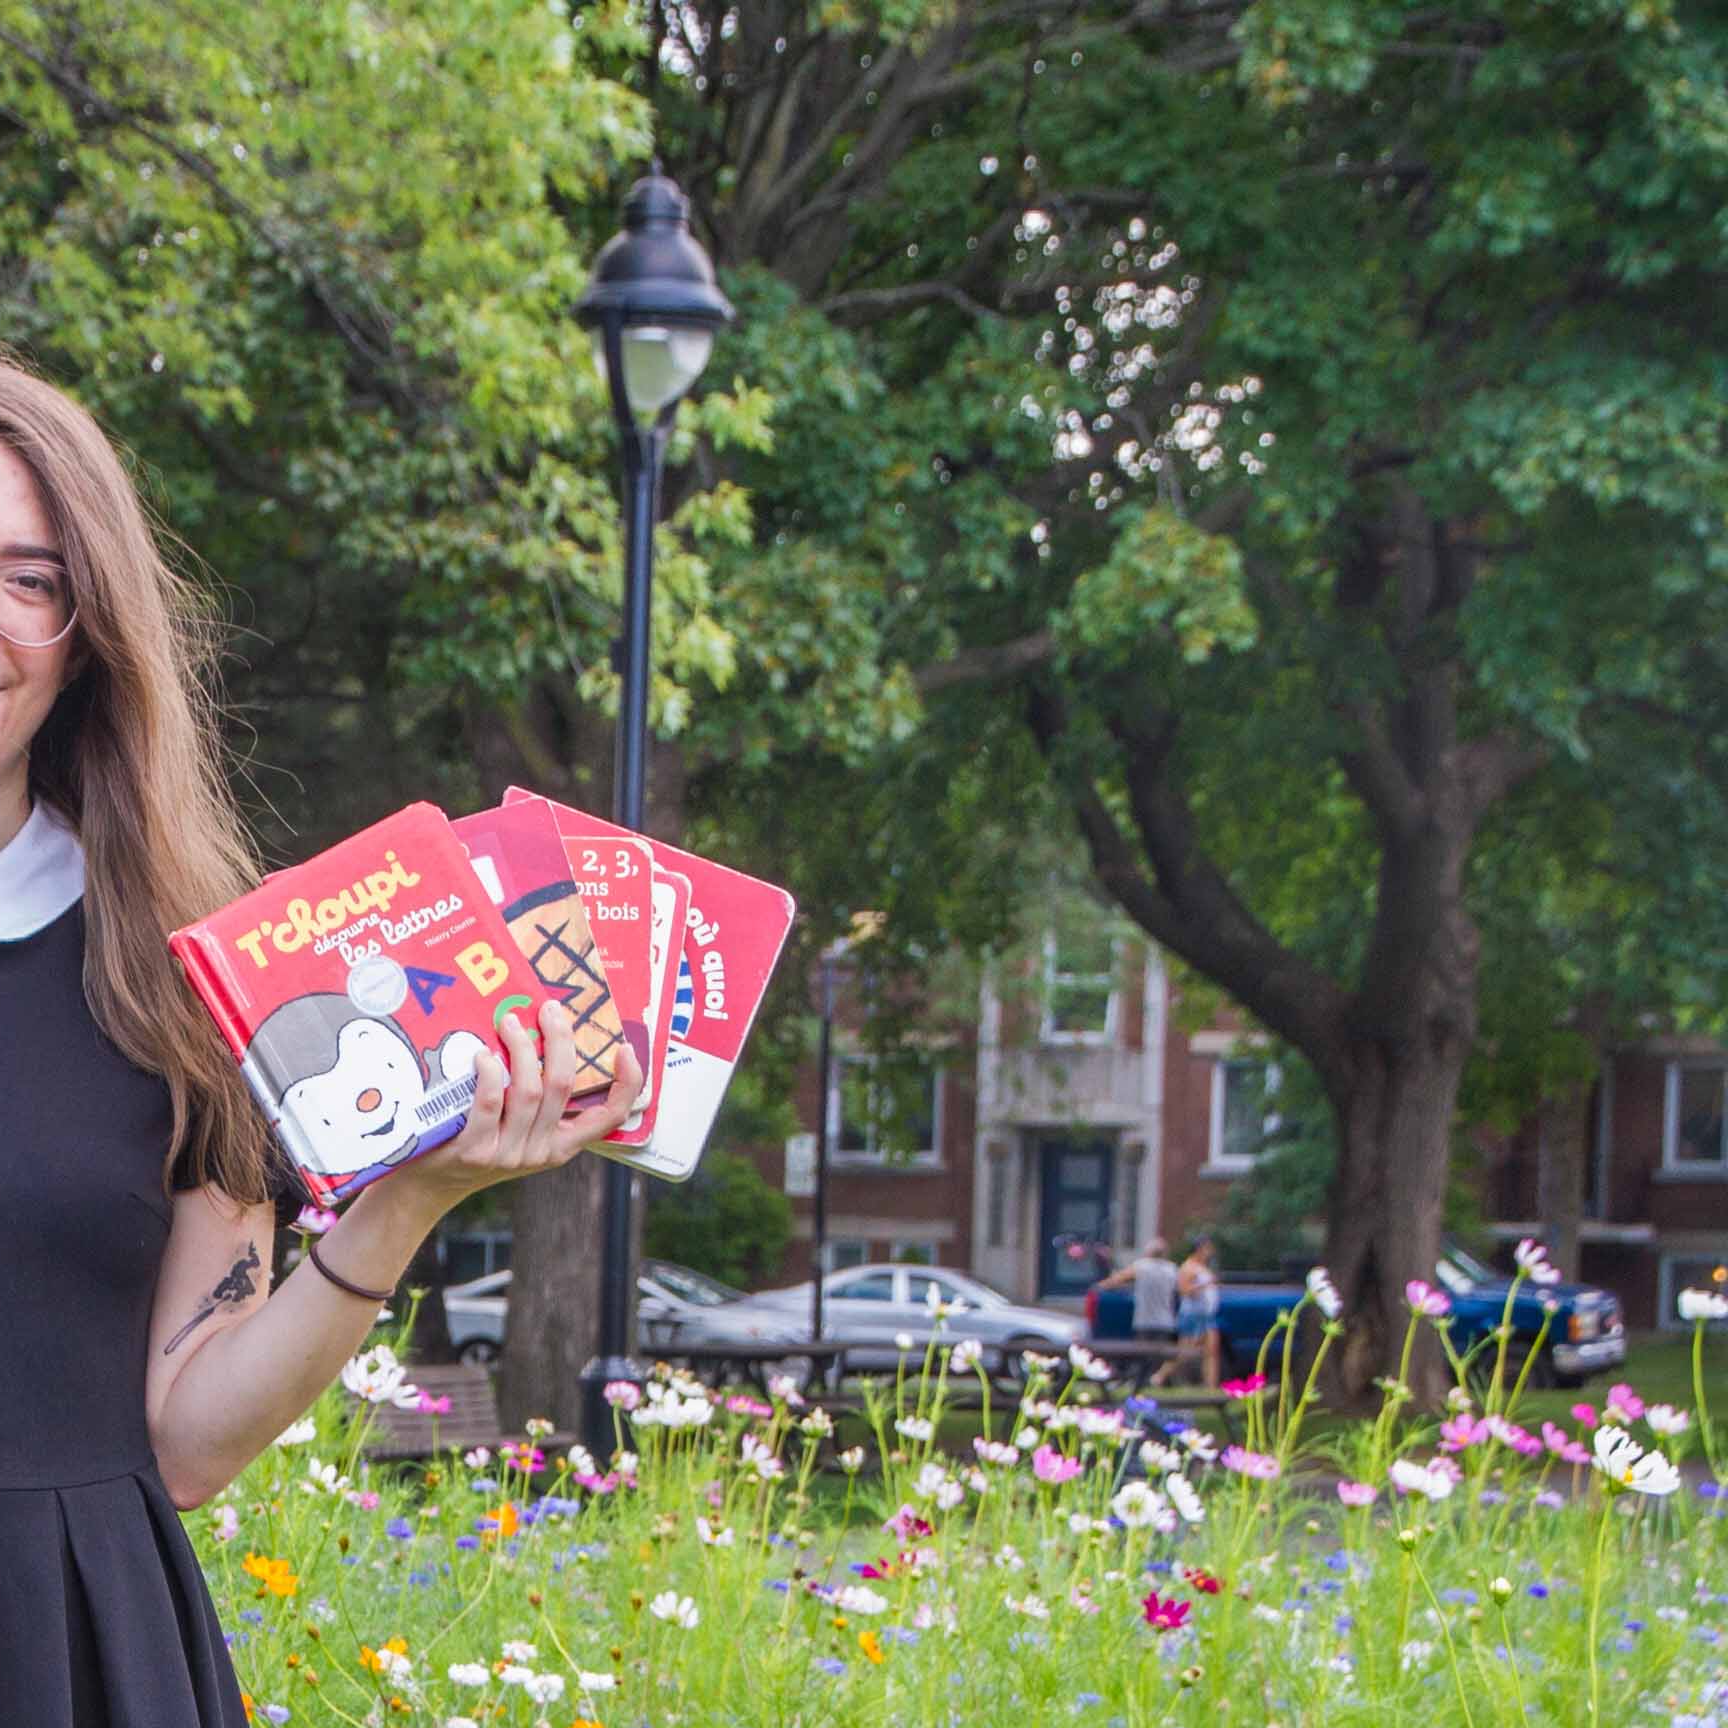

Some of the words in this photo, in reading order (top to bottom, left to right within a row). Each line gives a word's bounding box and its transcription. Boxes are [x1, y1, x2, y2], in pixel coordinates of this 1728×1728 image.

[235, 850, 421, 968] T'choupi
[575, 882, 609, 896] ons
[596, 901, 640, 921] bois
[314, 912, 381, 956] découvre
[379, 894, 463, 945] lettres
[404, 966, 456, 1016] A
[454, 941, 509, 997] B
[701, 950, 729, 1021] quoi
[667, 1055, 692, 1069] errin
